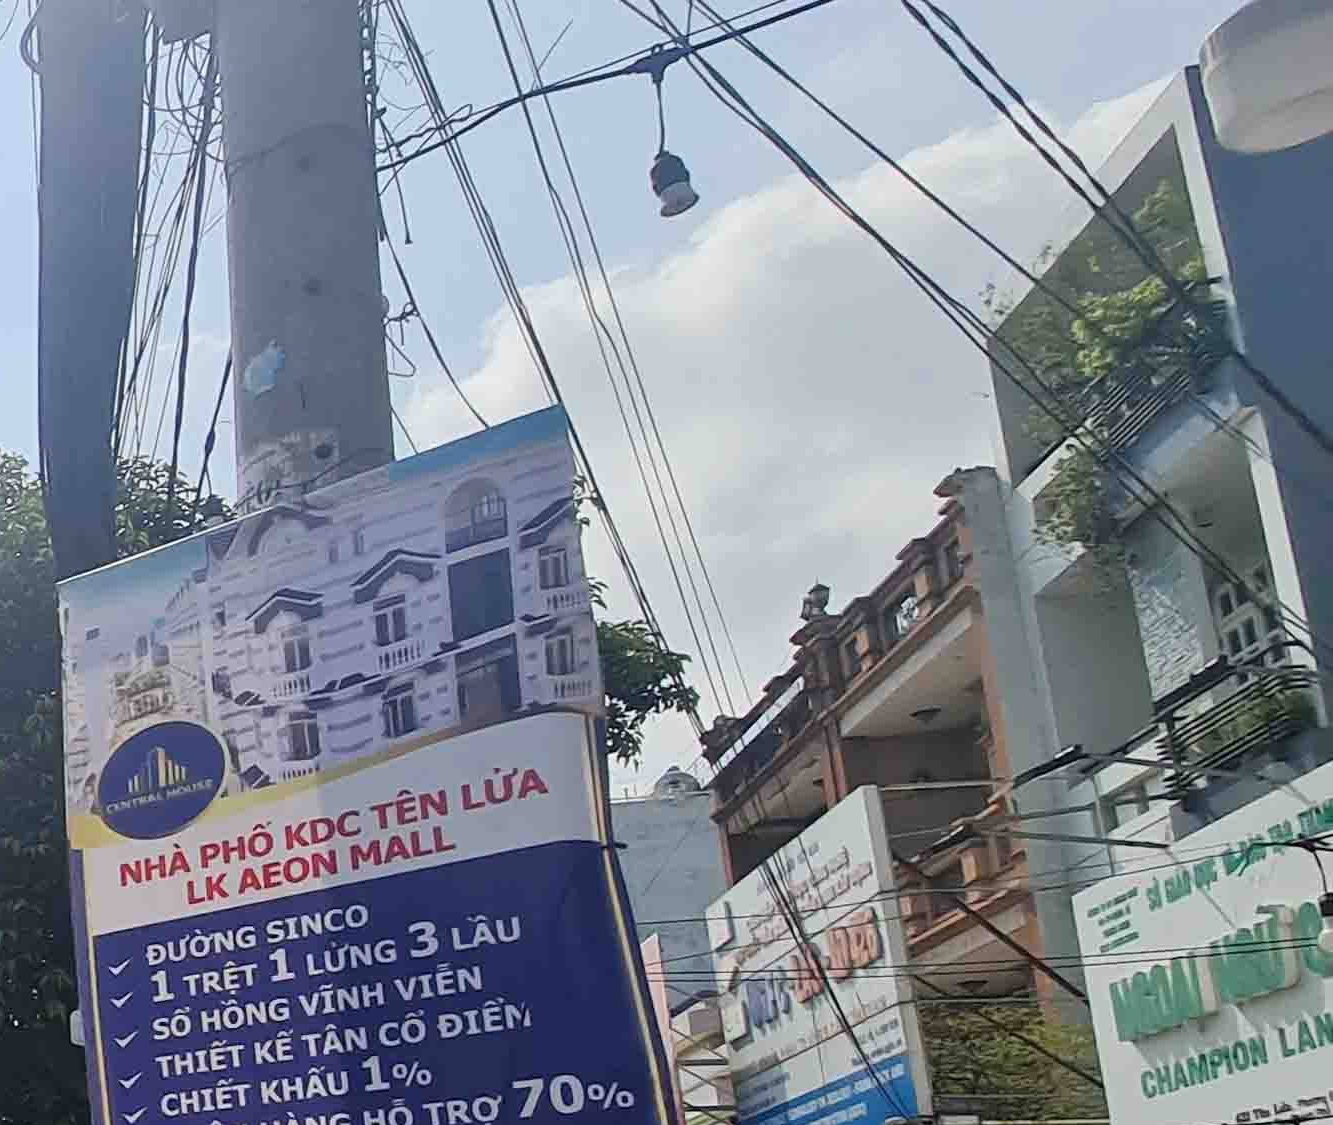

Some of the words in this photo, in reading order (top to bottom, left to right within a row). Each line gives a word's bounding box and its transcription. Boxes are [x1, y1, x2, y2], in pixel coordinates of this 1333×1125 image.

[166, 777, 215, 801] HOUSE
[120, 842, 192, 887] NHÀ
[200, 821, 275, 870] PHỐ
[284, 809, 362, 849] KDC
[370, 786, 449, 830] TÊN
[460, 765, 549, 811] LỬA
[186, 875, 229, 905] LK
[237, 848, 338, 894] AEON
[350, 825, 456, 870] MALL
[145, 925, 257, 966] ĐƯỜNG
[265, 904, 369, 946] SINCO
[149, 970, 176, 1003] 1
[181, 961, 259, 998] TRỆT
[268, 948, 296, 982] 1
[306, 938, 398, 978] LỪNG
[407, 921, 440, 959] 3
[451, 914, 522, 952] LẦU
[199, 998, 291, 1034] HỒNG
[298, 983, 386, 1020] VĨNH
[393, 963, 484, 1004] VIỄN
[154, 1038, 247, 1081] THIẾT
[252, 1029, 295, 1066] KẾ
[300, 1023, 370, 1058] TÂN
[1139, 1033, 1270, 1100] CHAMPION
[159, 1077, 253, 1118] CHIẾT
[259, 1065, 350, 1105] KHẤU
[510, 1072, 636, 1121] 70%
